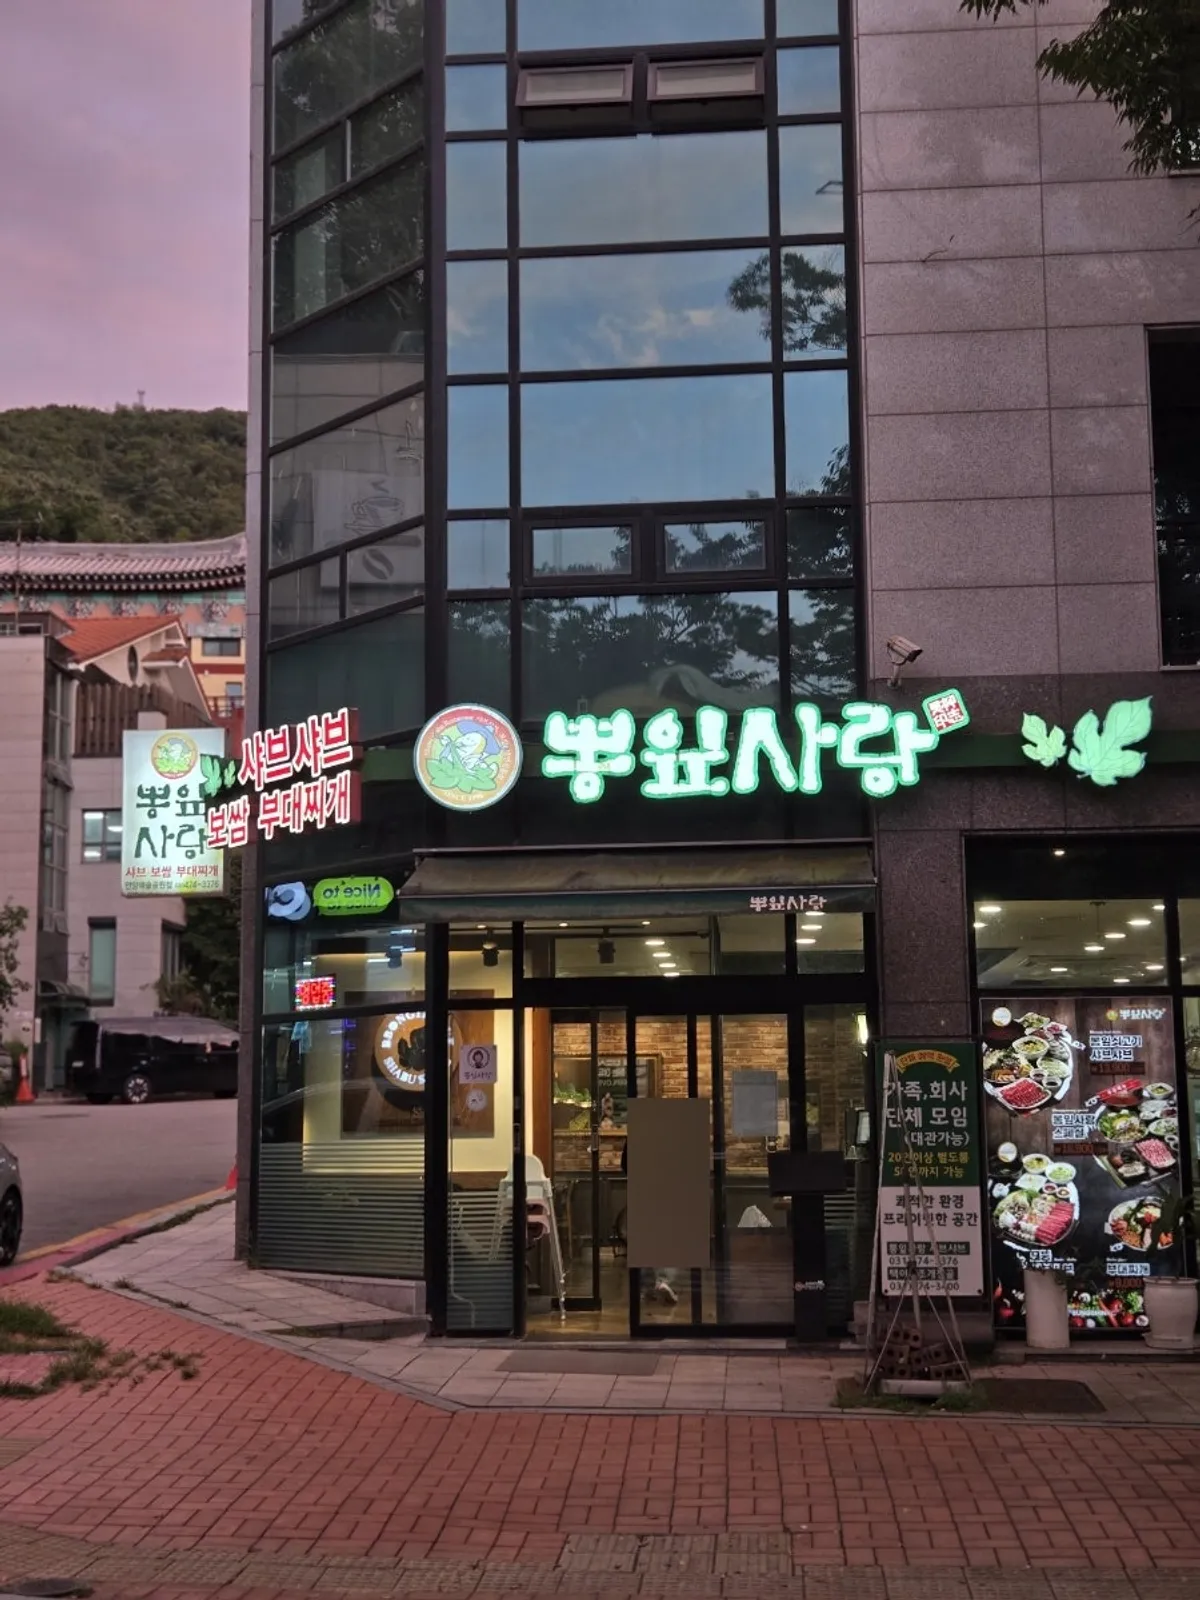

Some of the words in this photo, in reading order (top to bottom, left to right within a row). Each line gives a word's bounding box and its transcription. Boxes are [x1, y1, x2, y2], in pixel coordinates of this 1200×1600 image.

[238, 708, 353, 791] 샤브샤브
[543, 702, 940, 803] 뽕잎사랑
[136, 784, 206, 819] 뽕잎
[207, 795, 251, 848] 보쌈
[258, 771, 350, 840] 부대찌개
[135, 824, 213, 860] 사랑
[125, 866, 147, 878] 샤브
[151, 865, 172, 878] 보쌈
[176, 864, 219, 878] 부대찌개
[750, 894, 827, 912] 뽕잎사랑
[929, 1107, 967, 1128] 모임
[943, 1165, 965, 1178] 가능
[939, 1195, 964, 1209] 환경
[883, 1213, 947, 1227] 프라이한
[952, 1213, 978, 1227] 공간
